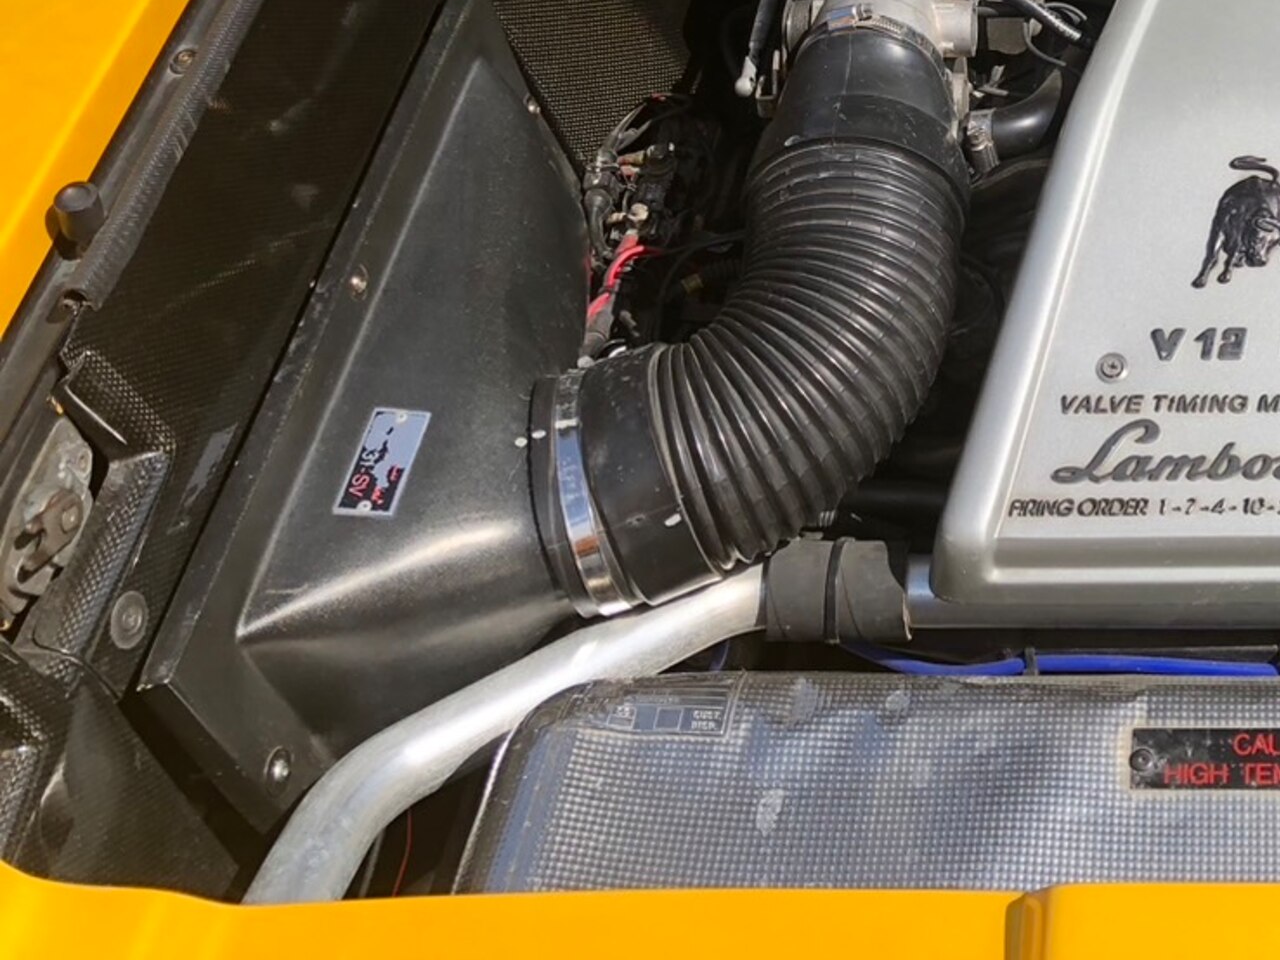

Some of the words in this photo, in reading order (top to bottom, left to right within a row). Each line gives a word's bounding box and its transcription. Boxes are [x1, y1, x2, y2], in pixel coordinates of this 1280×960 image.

[1150, 326, 1247, 362] V12
[1060, 393, 1144, 415] VALVE
[1152, 393, 1249, 415] TIMING
[1008, 498, 1075, 518] FIRING
[1077, 497, 1150, 517] ORDER
[1163, 763, 1230, 786] HIGH
